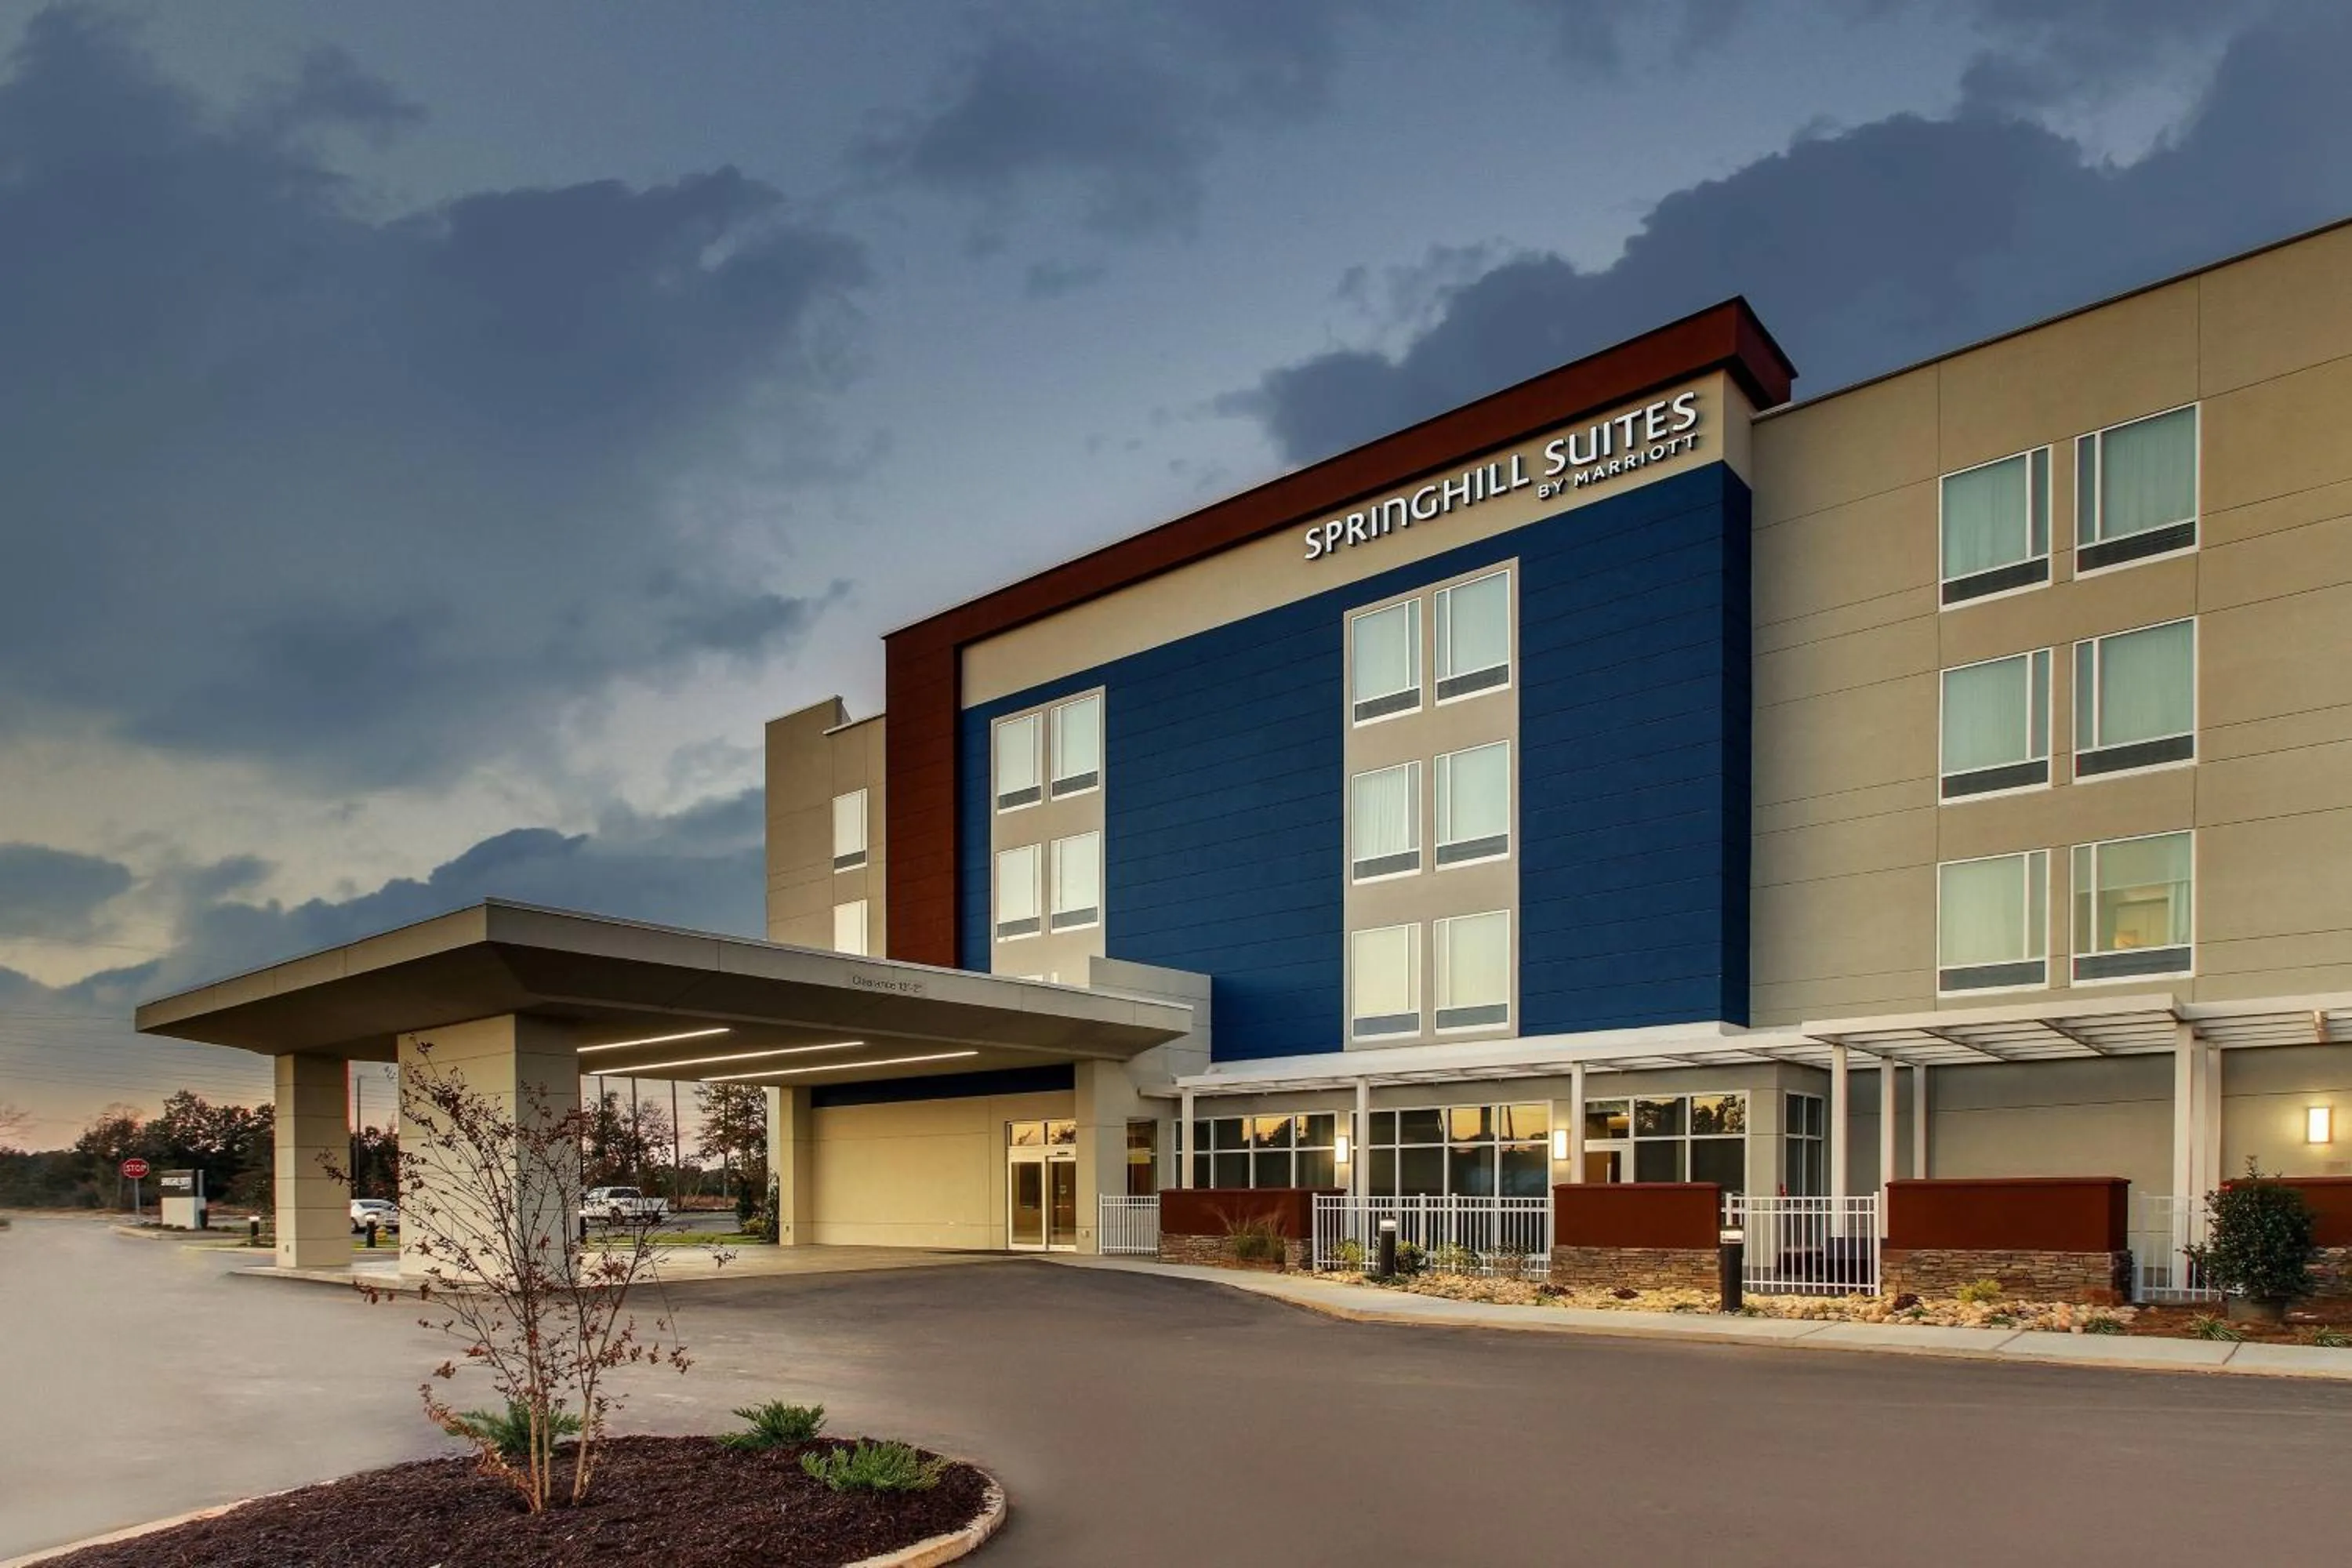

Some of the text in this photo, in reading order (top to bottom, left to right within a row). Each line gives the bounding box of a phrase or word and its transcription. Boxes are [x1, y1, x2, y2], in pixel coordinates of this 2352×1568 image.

[1304, 392, 1697, 560] SPRINGHILL SUITES
[1538, 432, 1697, 499] BY MARRIOTT
